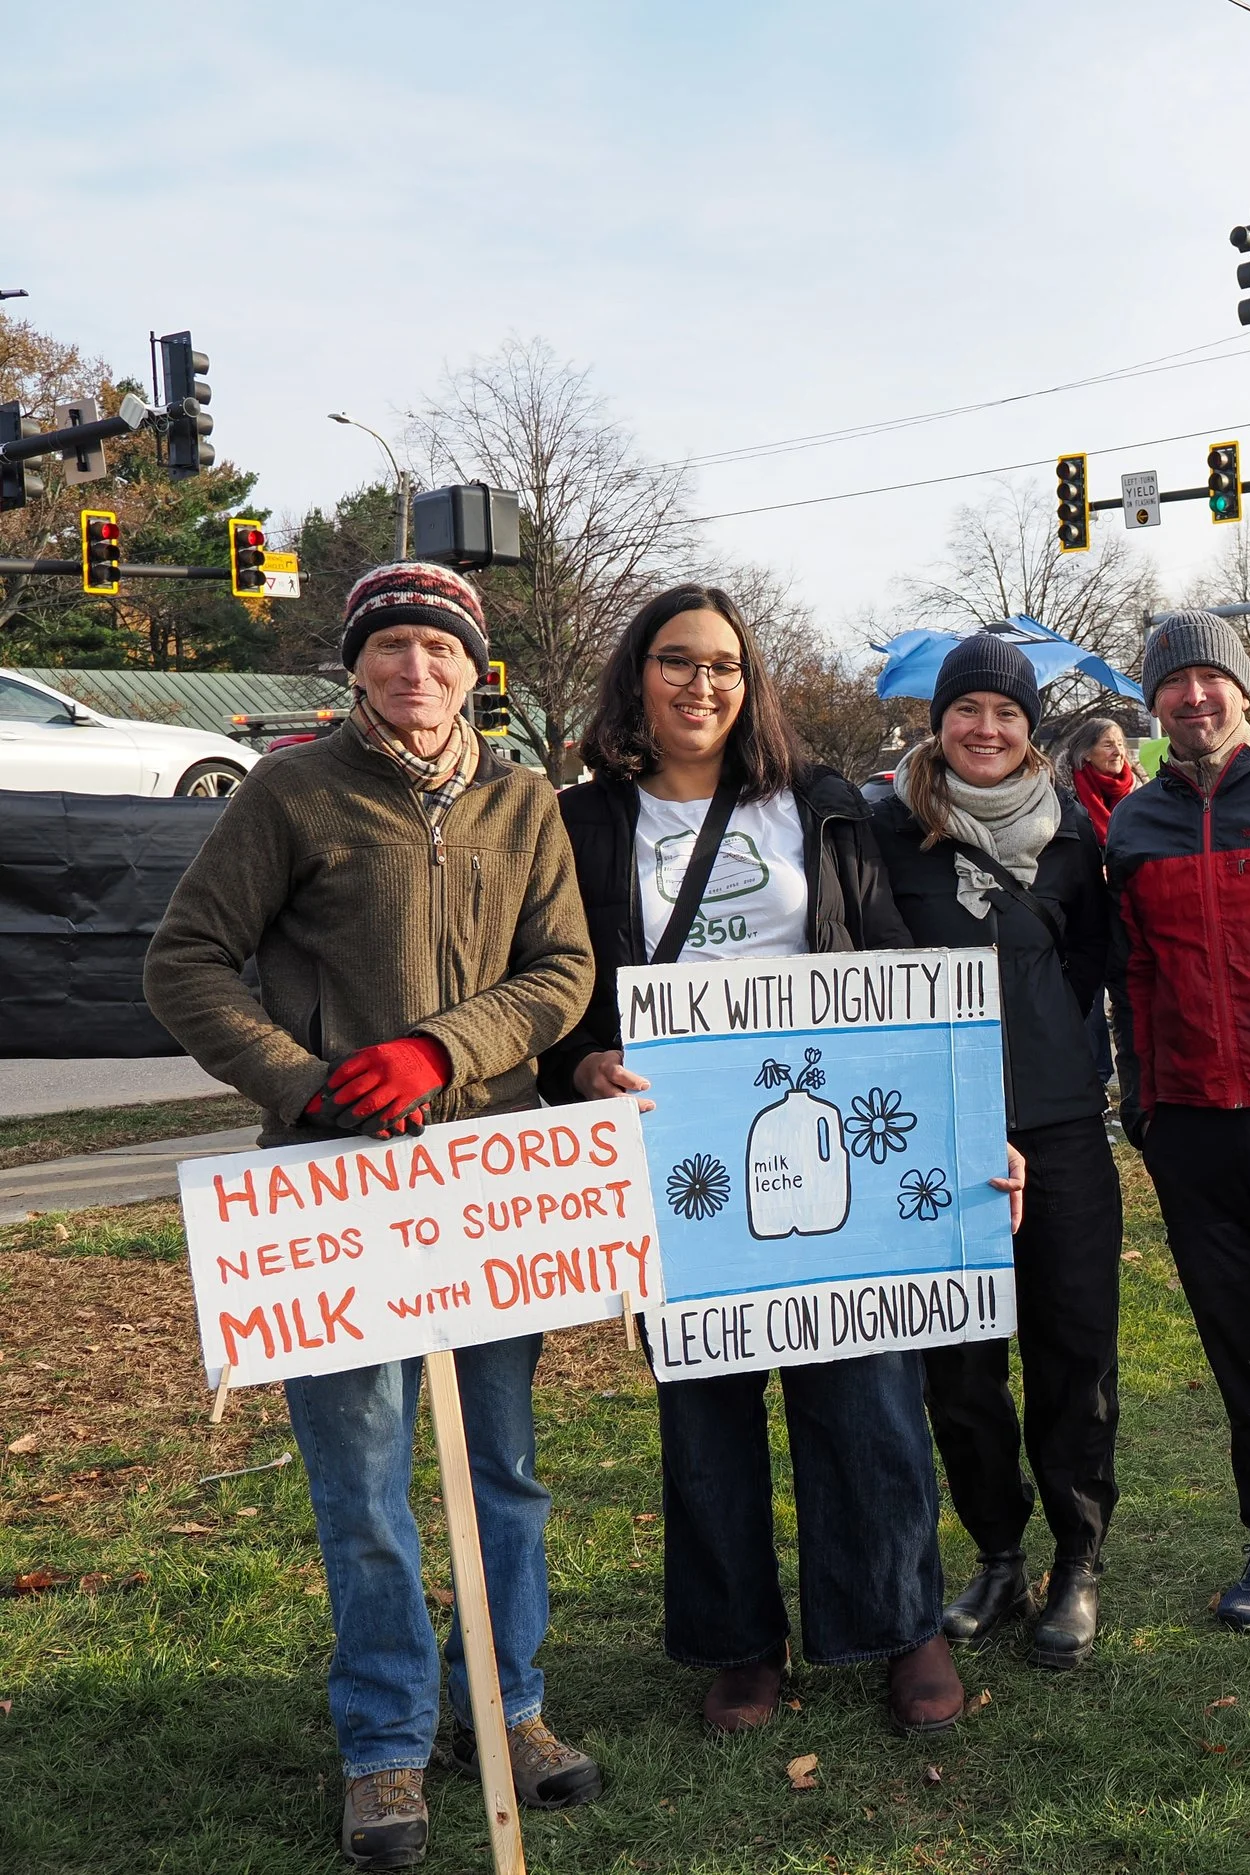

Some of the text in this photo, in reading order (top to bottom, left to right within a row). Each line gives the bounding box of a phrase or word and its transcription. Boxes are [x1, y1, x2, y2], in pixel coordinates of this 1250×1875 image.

[1125, 485, 1155, 498] YIELD
[686, 915, 759, 948] 350 VT
[629, 979, 710, 1040] MILK
[724, 973, 793, 1031] WITH
[810, 963, 942, 1025] DIGNITY
[213, 1120, 619, 1223] HANNAFORDS
[753, 1154, 790, 1173] milk
[754, 1173, 803, 1193] leche
[217, 1179, 632, 1285] NEEDS TO SUPPORT
[219, 1234, 651, 1366] MILK WITH DIGNITY
[662, 1298, 755, 1370] LECHE
[767, 1296, 820, 1354] CON
[832, 1276, 970, 1348] DIGNIDAD
